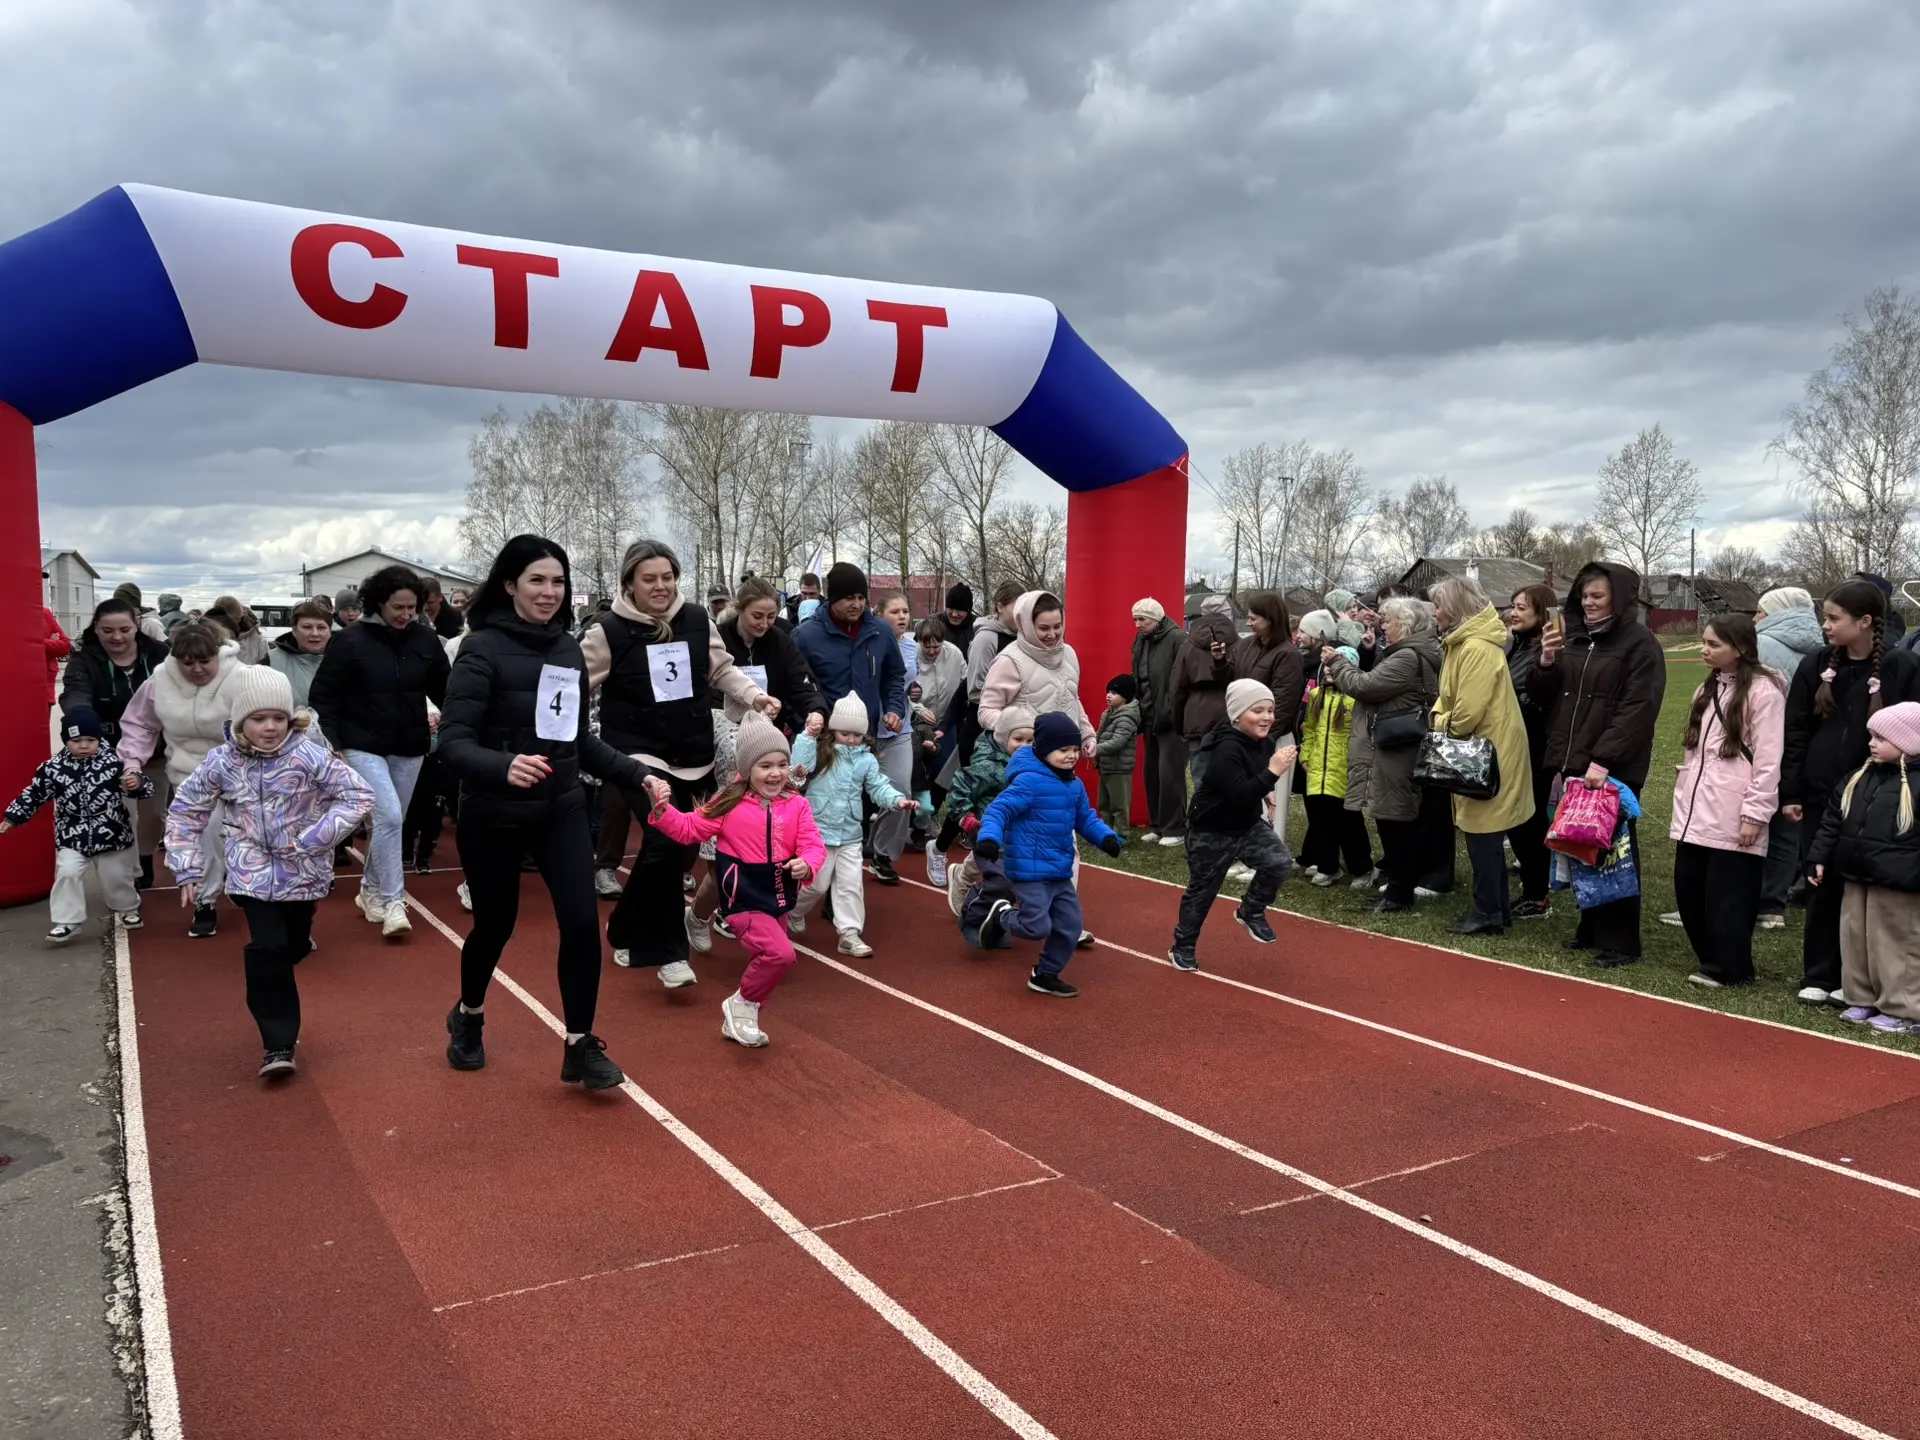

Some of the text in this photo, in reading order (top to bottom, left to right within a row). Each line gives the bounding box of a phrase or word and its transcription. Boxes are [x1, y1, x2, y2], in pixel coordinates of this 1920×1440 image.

[290, 223, 949, 393] СТАРТ
[664, 661, 678, 682] 3
[549, 690, 562, 716] 4
[89, 788, 112, 813] RUN
